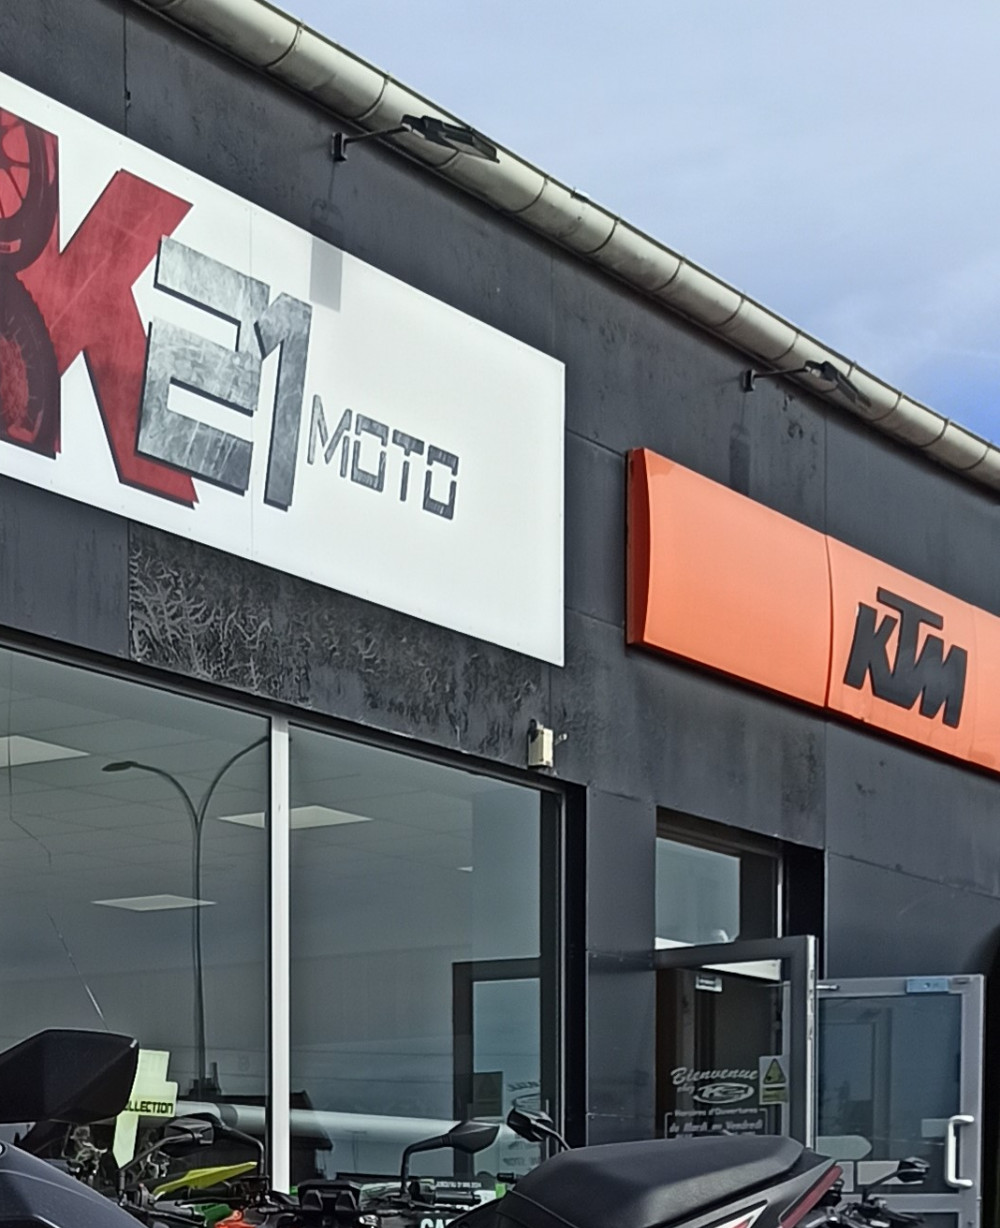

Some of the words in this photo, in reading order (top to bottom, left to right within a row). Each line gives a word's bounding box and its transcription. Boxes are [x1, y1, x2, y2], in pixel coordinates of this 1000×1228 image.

[307, 394, 459, 520] MOTO
[843, 586, 968, 729] KTM
[124, 1101, 173, 1114] LLECTION
[670, 1067, 758, 1085] Bienvenue
